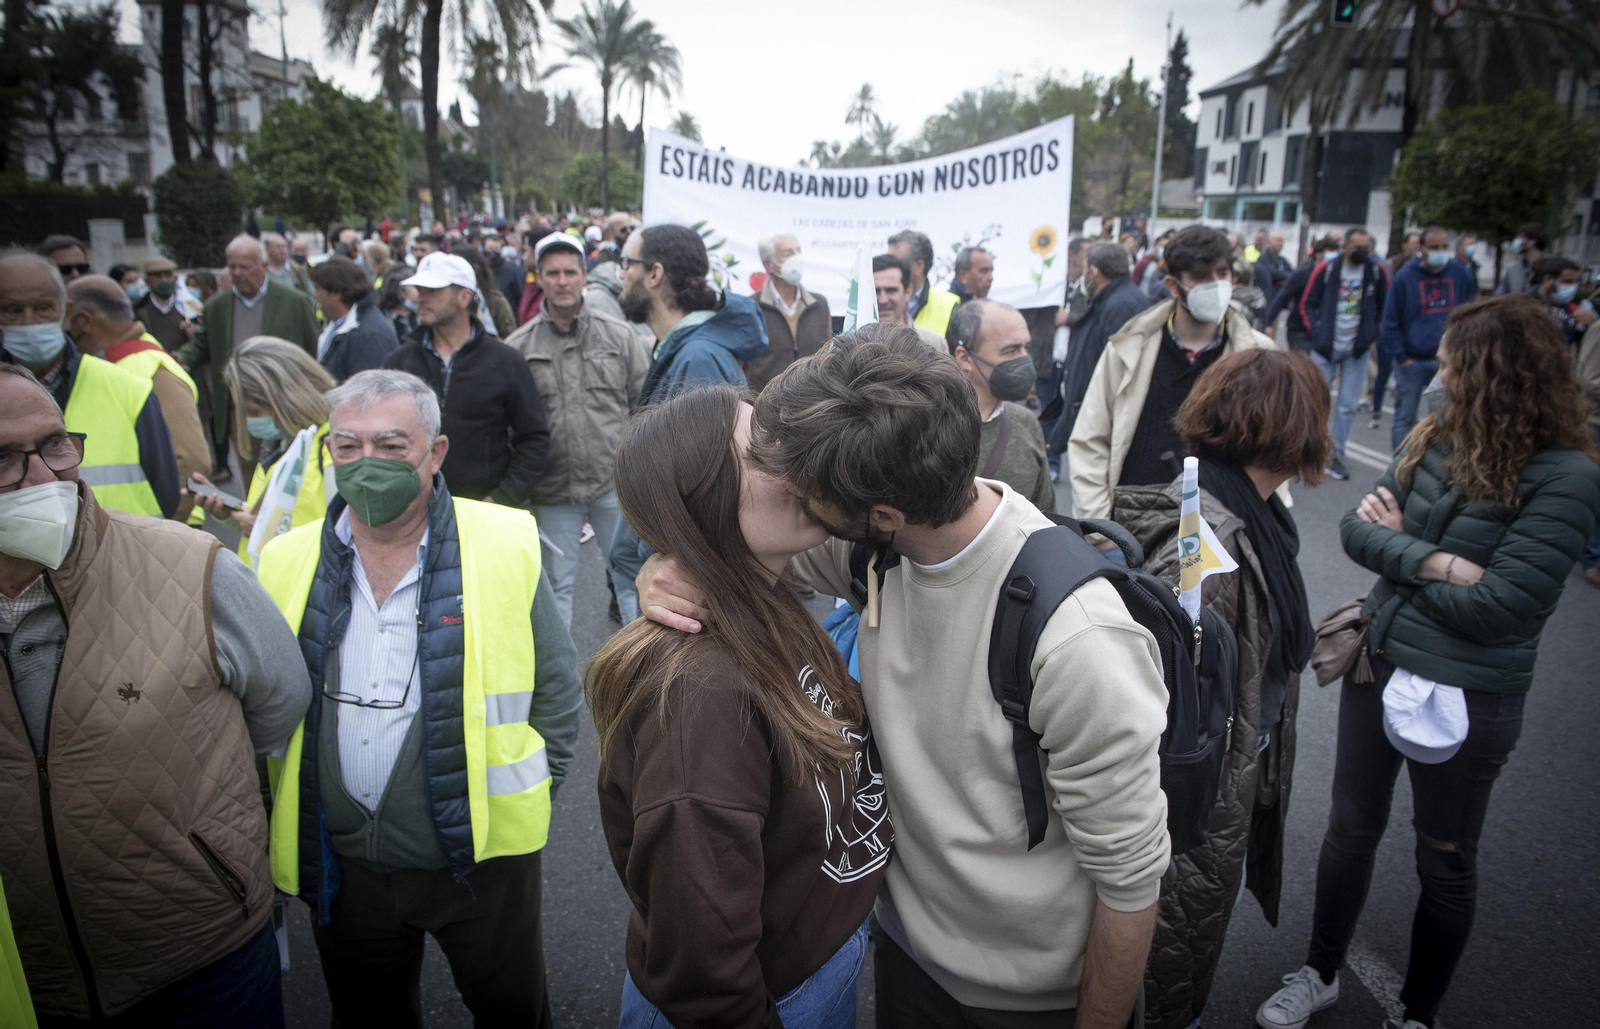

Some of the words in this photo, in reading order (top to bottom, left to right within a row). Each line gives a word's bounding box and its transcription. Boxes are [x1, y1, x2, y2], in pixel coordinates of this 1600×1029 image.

[742, 162, 868, 198] ACABANDO
[878, 169, 924, 197] CON
[933, 139, 1060, 192] NOSOTROS
